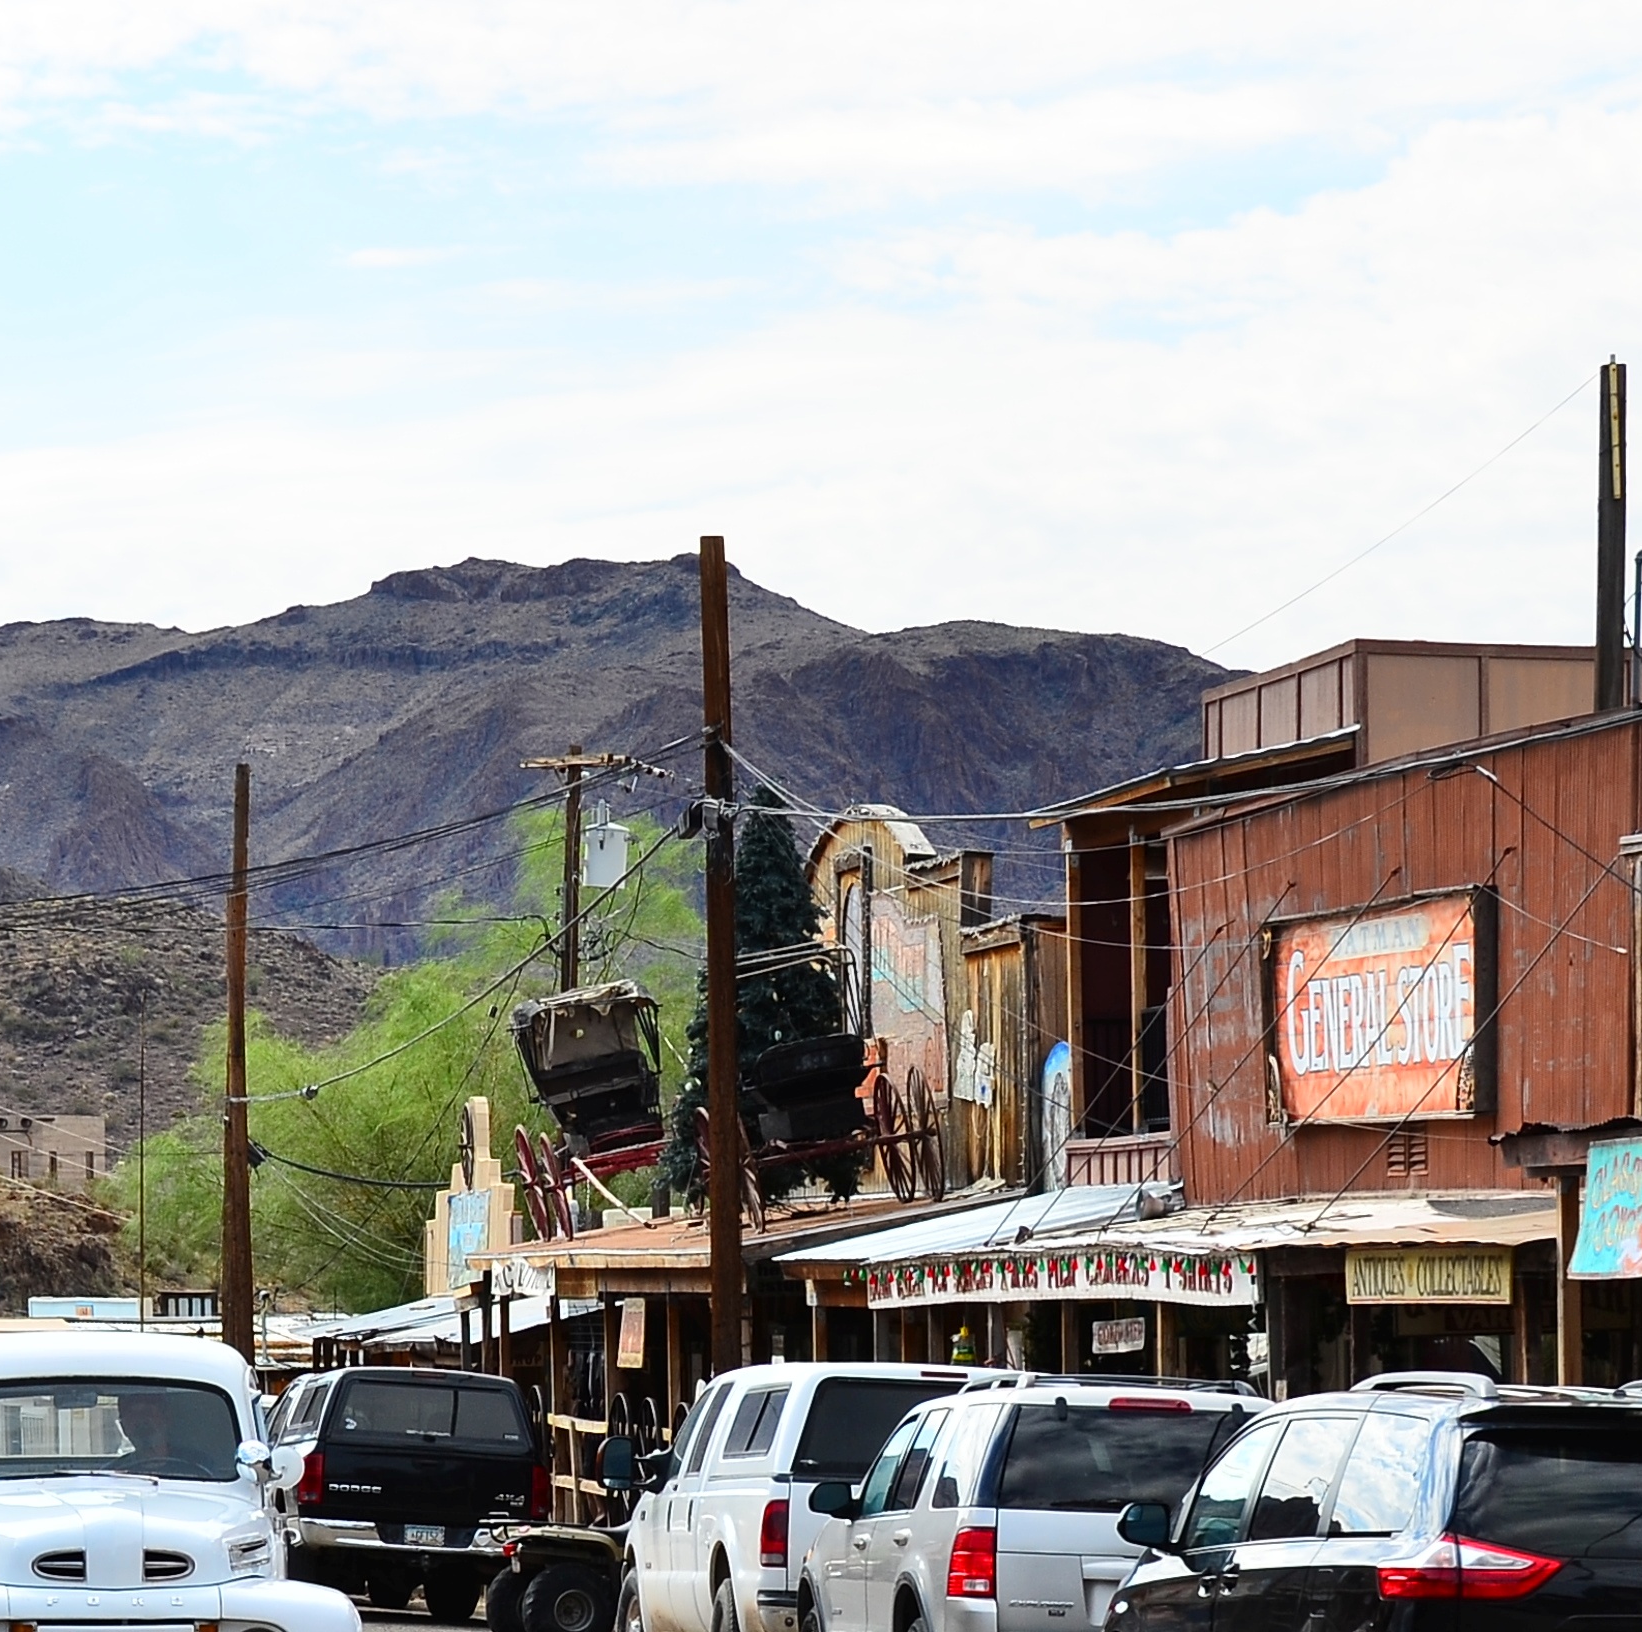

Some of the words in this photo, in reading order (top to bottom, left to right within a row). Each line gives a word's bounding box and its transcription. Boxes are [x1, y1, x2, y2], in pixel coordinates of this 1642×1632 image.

[1396, 941, 1472, 1066] STORE
[1416, 1255, 1504, 1296] COLLECTABLES
[329, 1483, 382, 1494] DODGE
